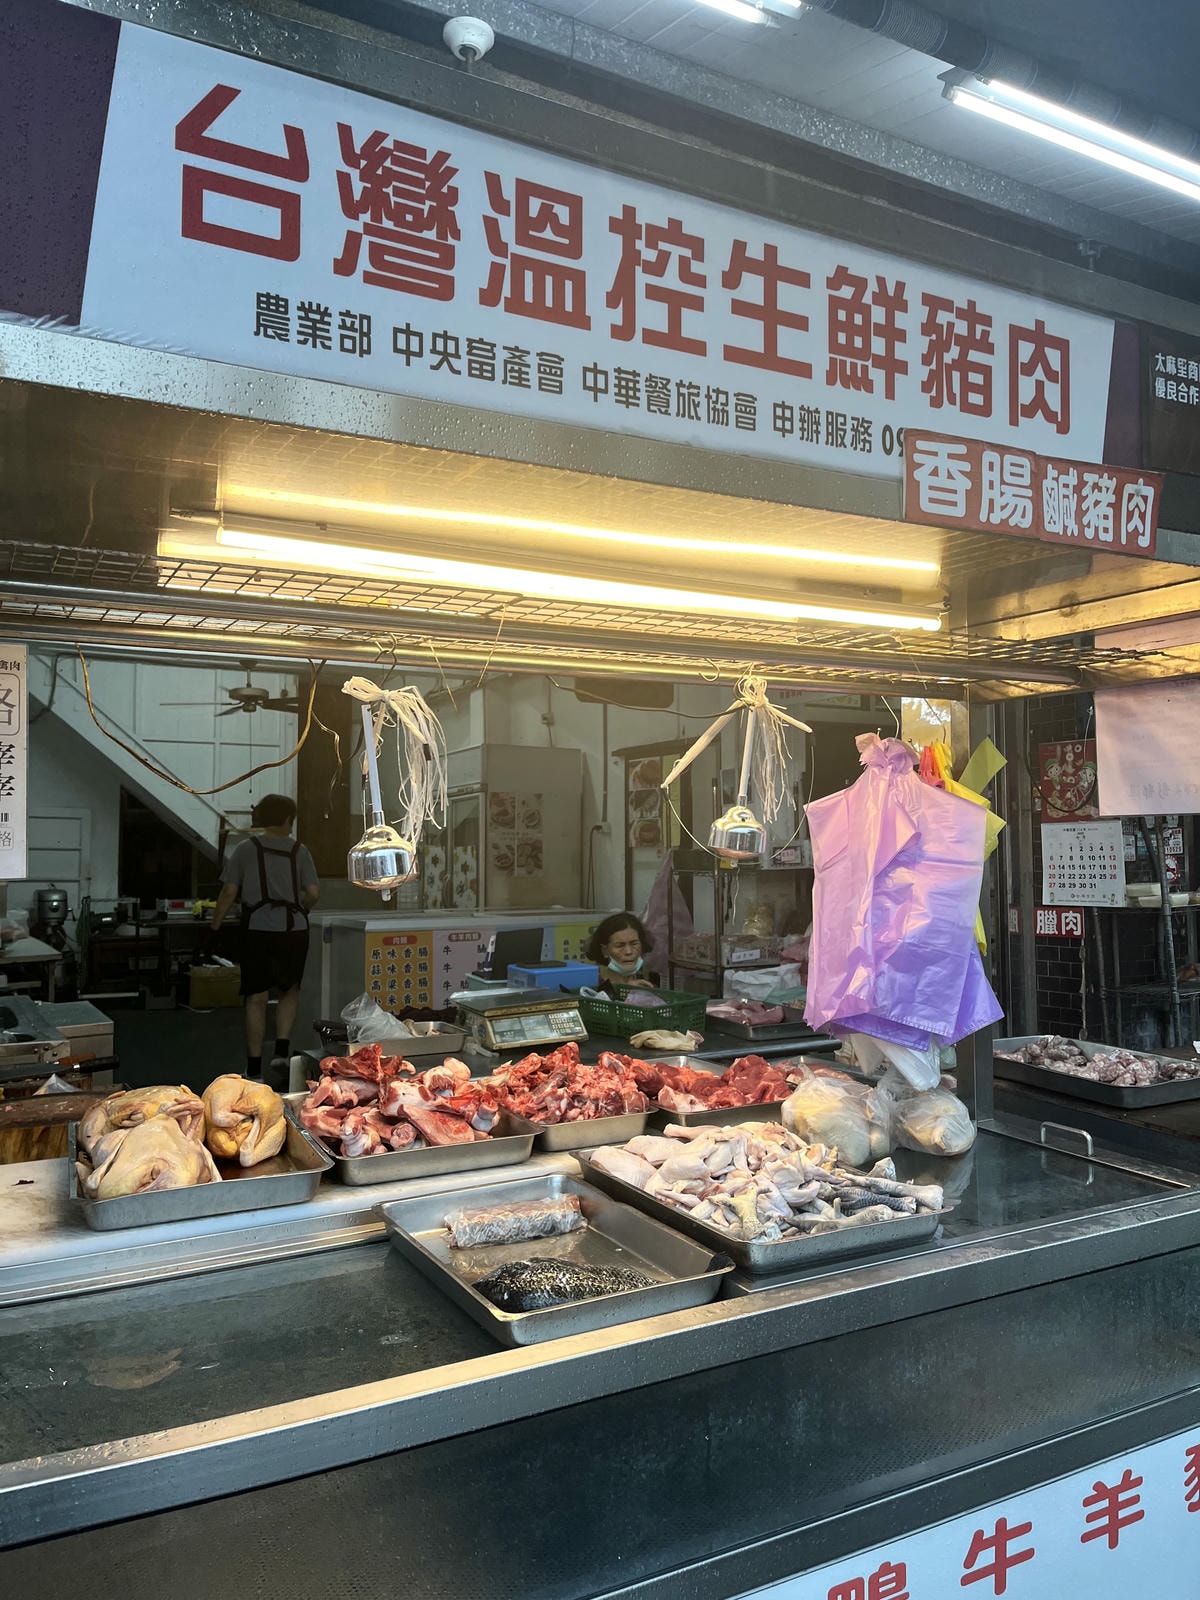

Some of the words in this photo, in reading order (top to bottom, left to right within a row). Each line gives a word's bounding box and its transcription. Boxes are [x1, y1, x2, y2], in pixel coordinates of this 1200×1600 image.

[174, 83, 1071, 435] 台灣溫控生鮮豬肉
[253, 292, 372, 358] 農業部
[392, 322, 564, 395] 中央畜產會
[582, 362, 757, 432] 中華餐旅協會
[772, 401, 873, 454] 申辦服務
[1155, 353, 1200, 382] 太麻里商
[1155, 377, 1199, 406] 優良合作
[913, 440, 1034, 529] 香腸
[1042, 463, 1154, 548] 鹹豬肉
[371, 947, 429, 960] 原味香腸
